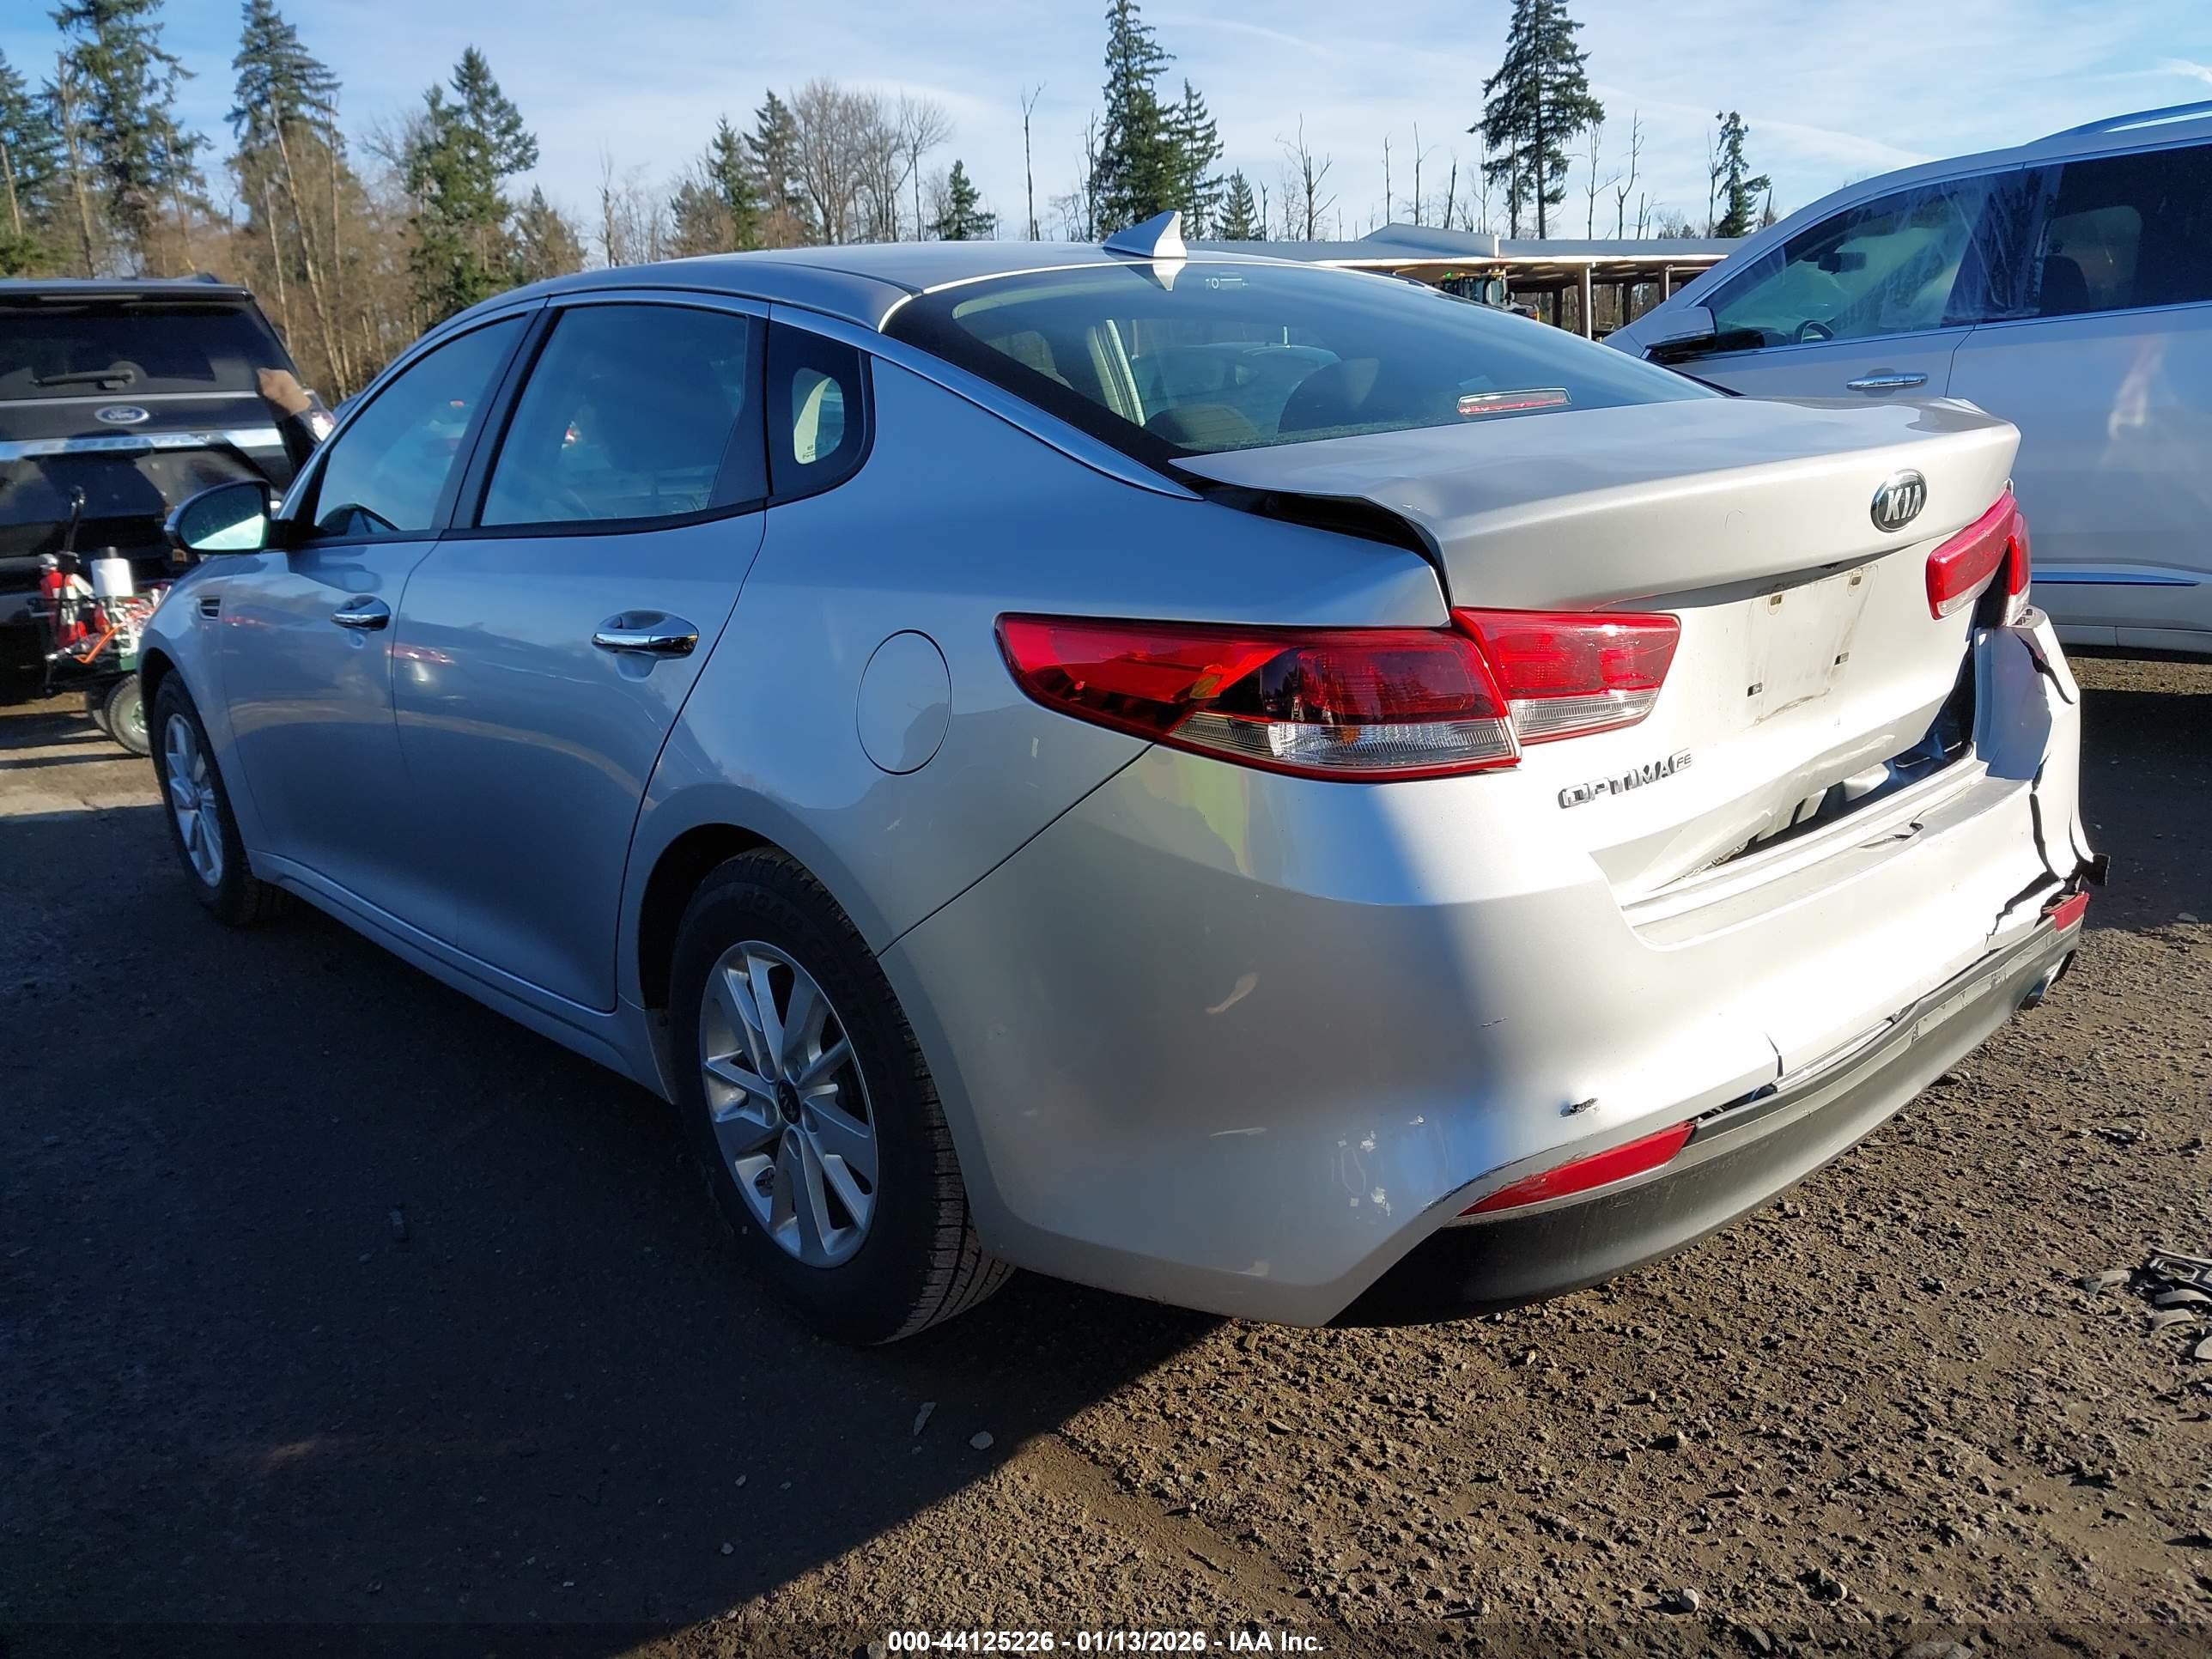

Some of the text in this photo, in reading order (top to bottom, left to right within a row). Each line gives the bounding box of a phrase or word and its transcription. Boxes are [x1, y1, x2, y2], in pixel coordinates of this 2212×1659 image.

[1883, 484, 1922, 522] KIA
[1558, 753, 1692, 810] OPTIMA FE
